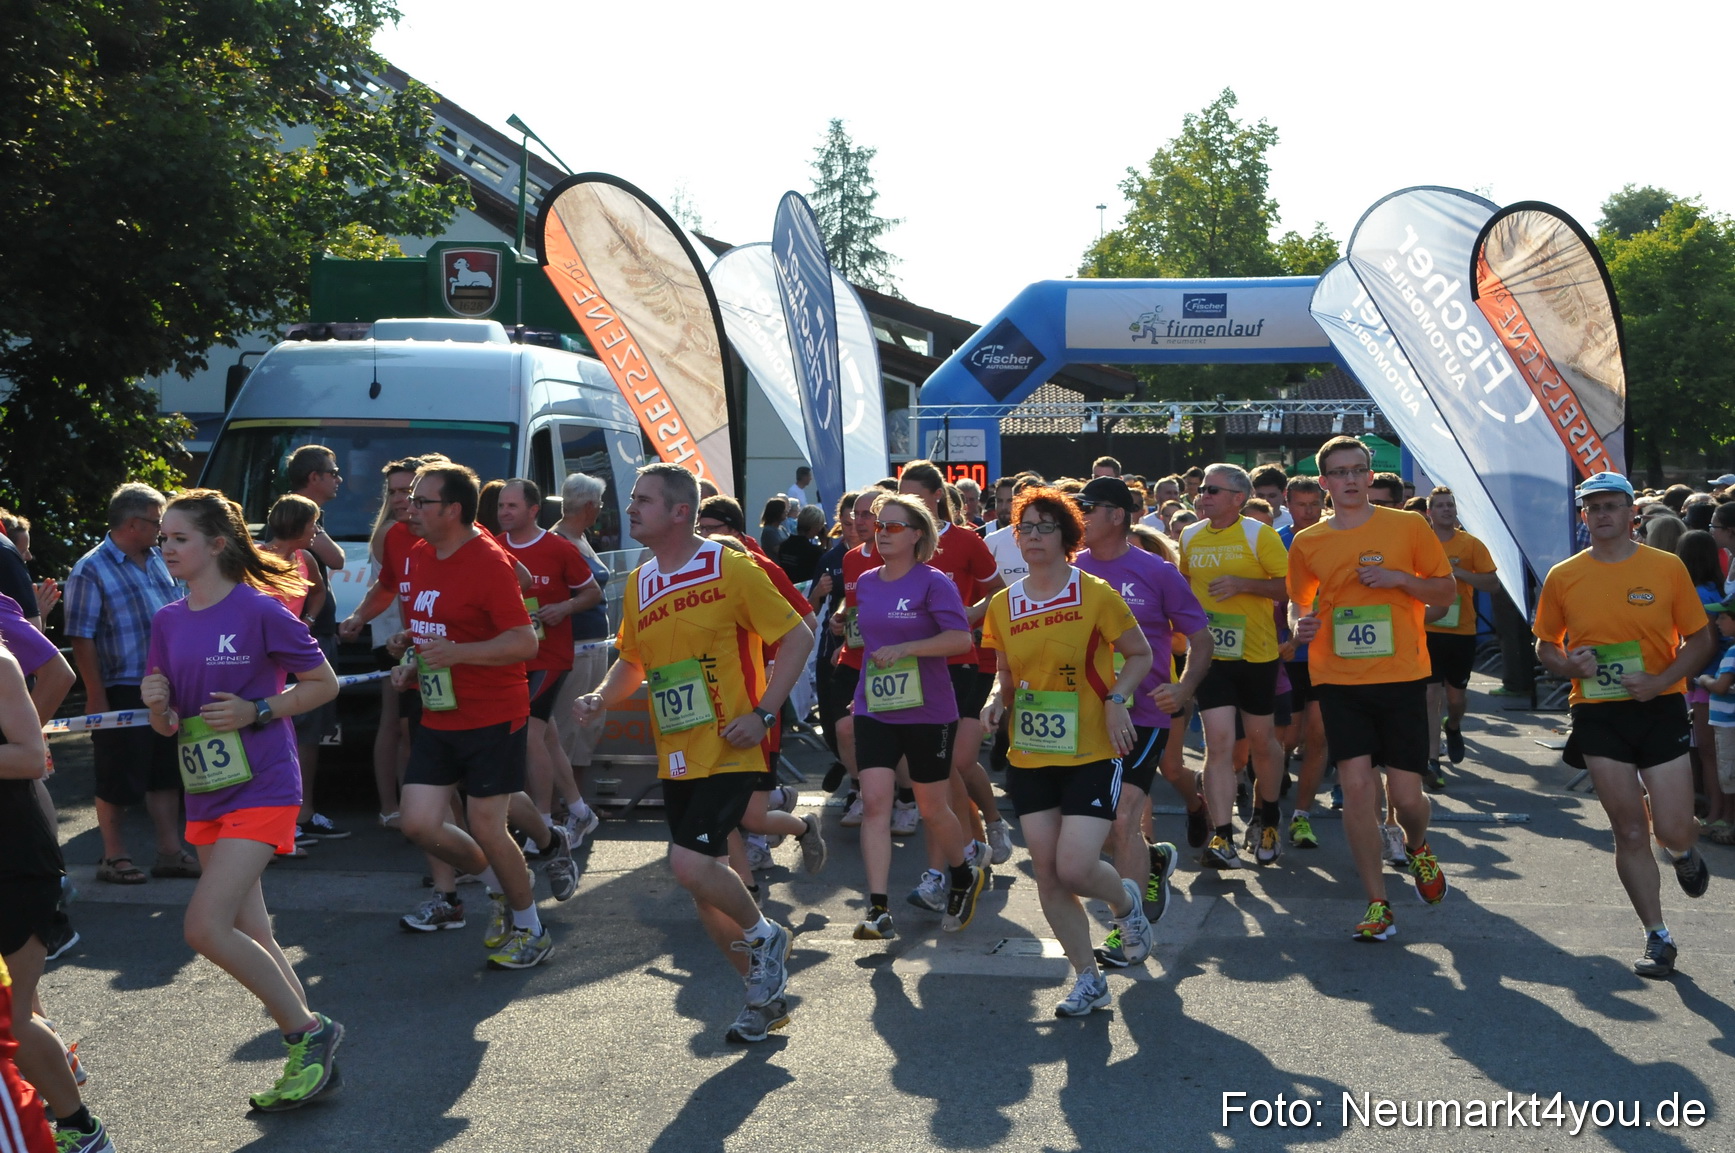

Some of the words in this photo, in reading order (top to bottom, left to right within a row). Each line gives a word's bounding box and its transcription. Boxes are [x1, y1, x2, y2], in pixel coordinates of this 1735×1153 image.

[1192, 301, 1225, 311] Fischer
[1166, 318, 1265, 337] firmenlauf
[1166, 337, 1207, 345] neumarkt
[981, 353, 1033, 365] Fischer
[1189, 553, 1222, 569] RUN
[1121, 583, 1135, 597] K
[637, 603, 670, 633] MAX
[673, 586, 727, 613] BÖGL
[896, 598, 911, 611] K
[1009, 619, 1040, 636] MAX
[1044, 610, 1083, 626] BÖGL
[218, 634, 237, 654] K
[1209, 628, 1236, 648] 36
[1347, 624, 1376, 646] 46
[1596, 662, 1625, 687] 53
[871, 673, 909, 698] 607
[655, 683, 695, 718] 797
[1020, 711, 1066, 738] 833
[182, 738, 231, 776] 613
